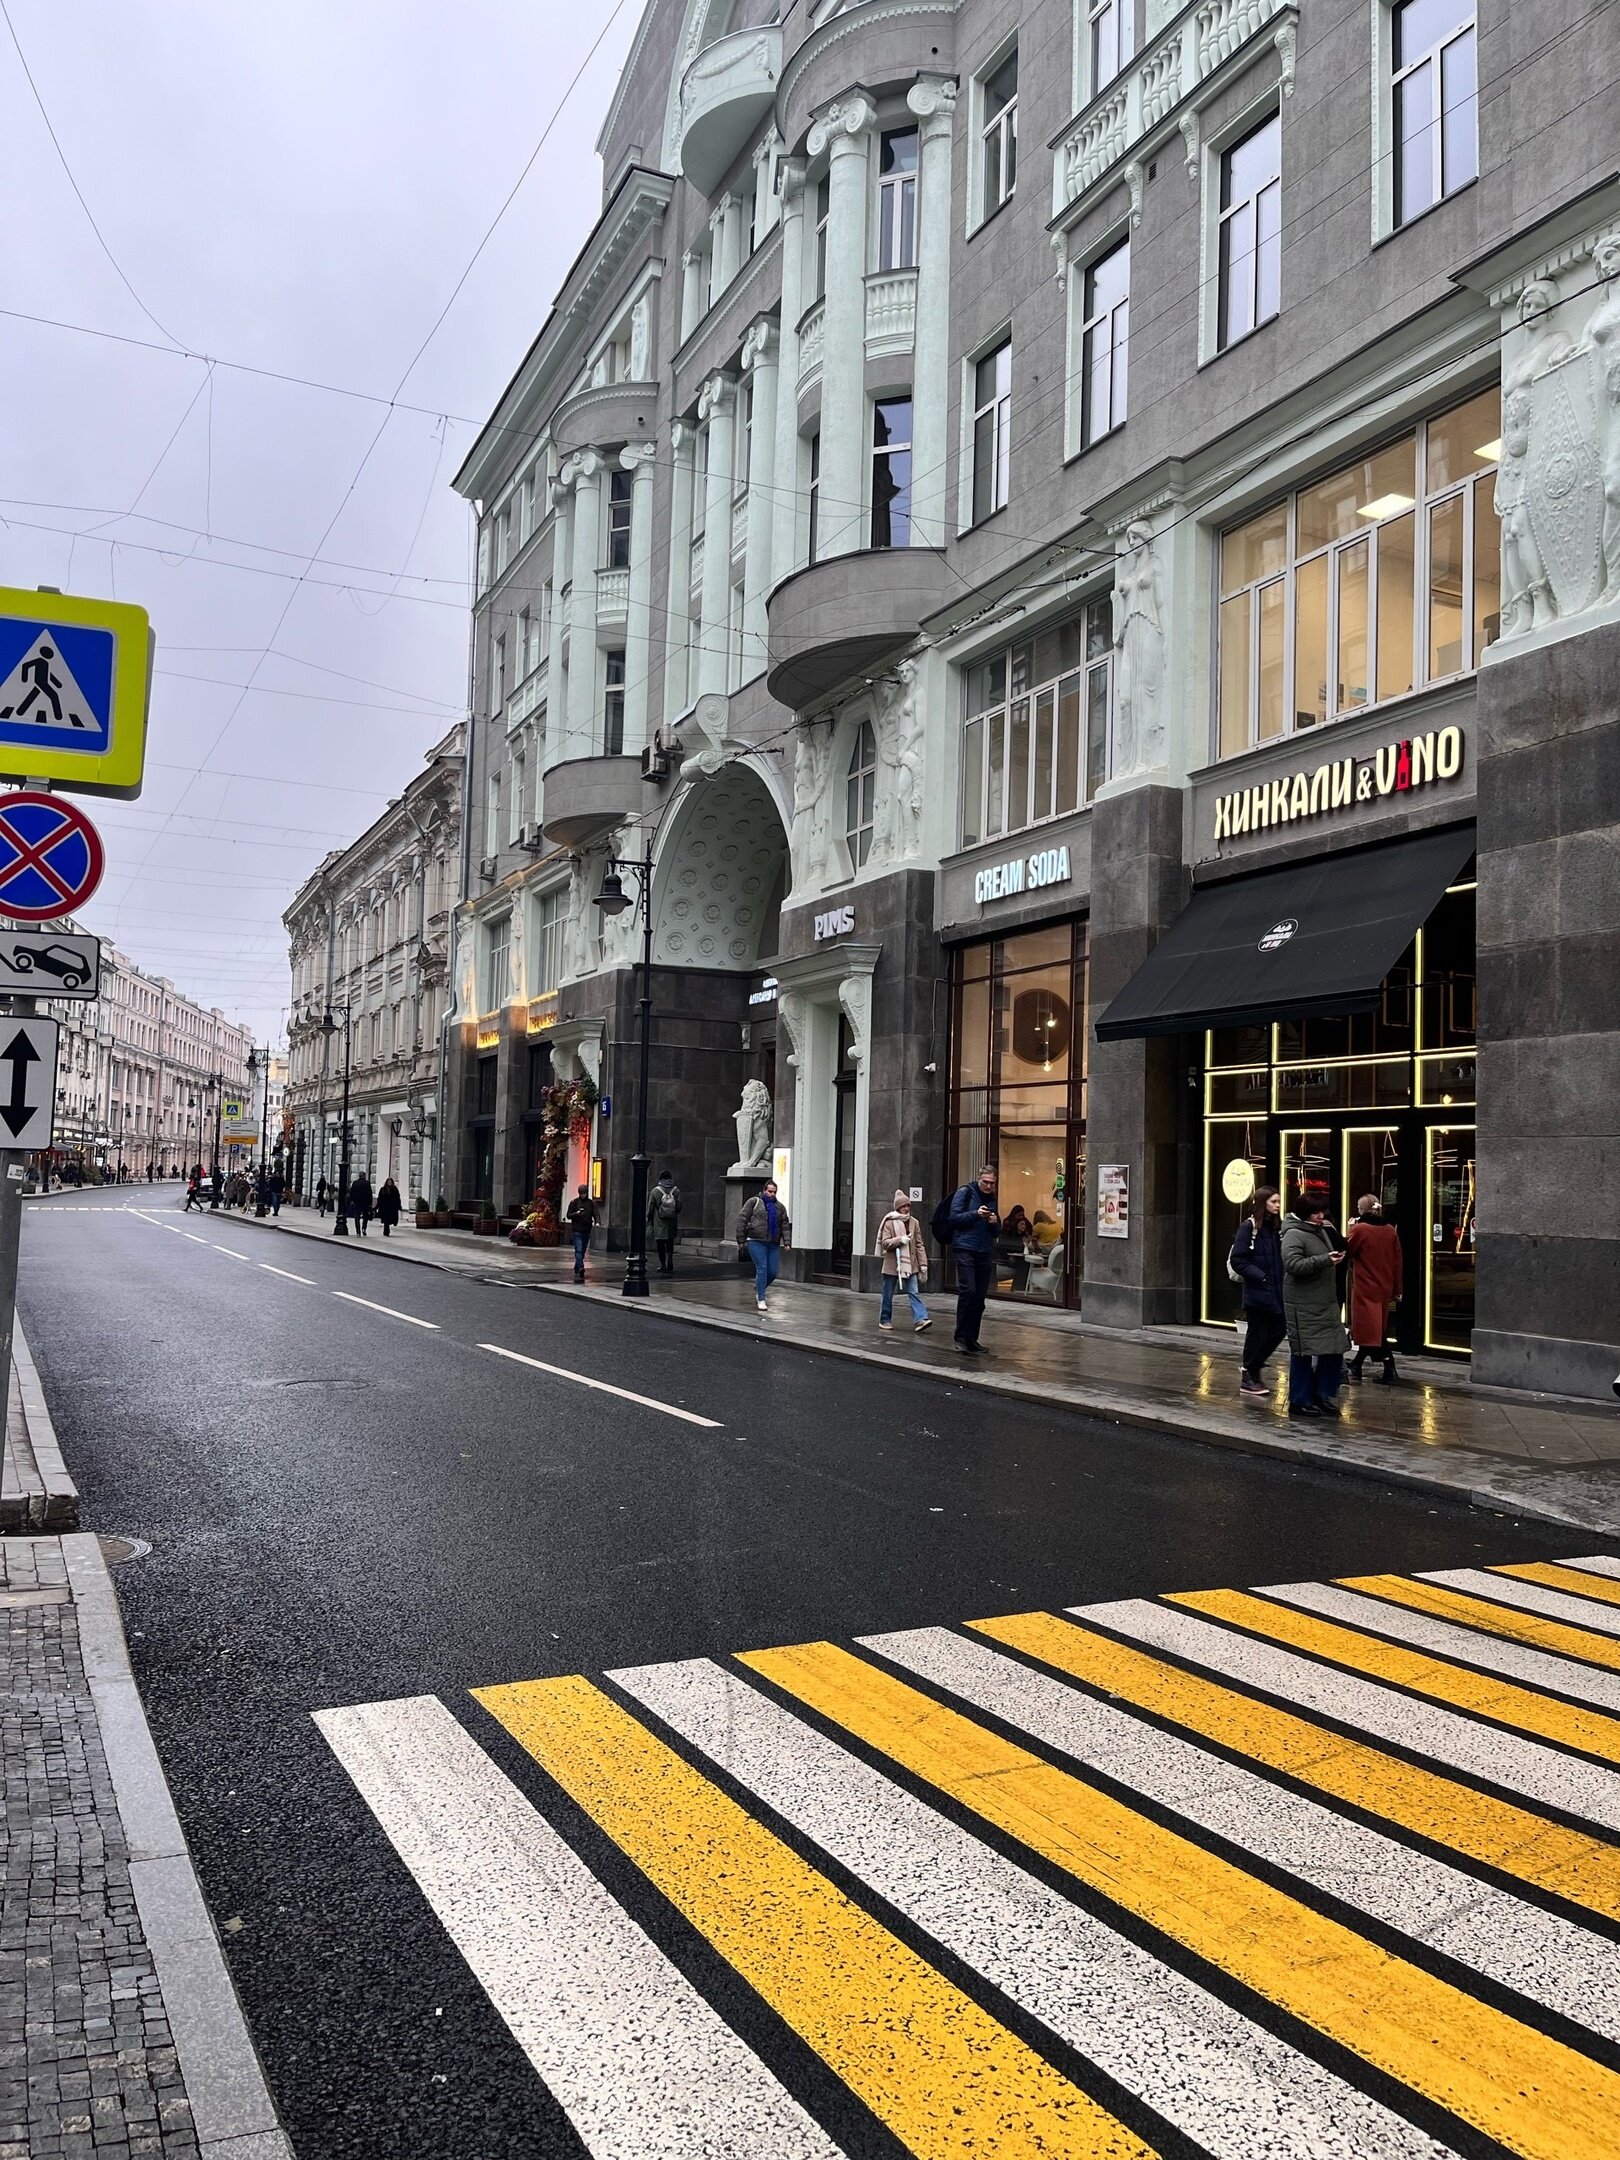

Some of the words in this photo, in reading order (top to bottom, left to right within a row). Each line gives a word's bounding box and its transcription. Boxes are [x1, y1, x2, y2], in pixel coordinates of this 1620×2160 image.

[1214, 757, 1353, 840] ХИНКАЛИ
[974, 858, 1025, 904] CREAM
[1027, 845, 1070, 889] SODA
[813, 905, 855, 941] PIMS
